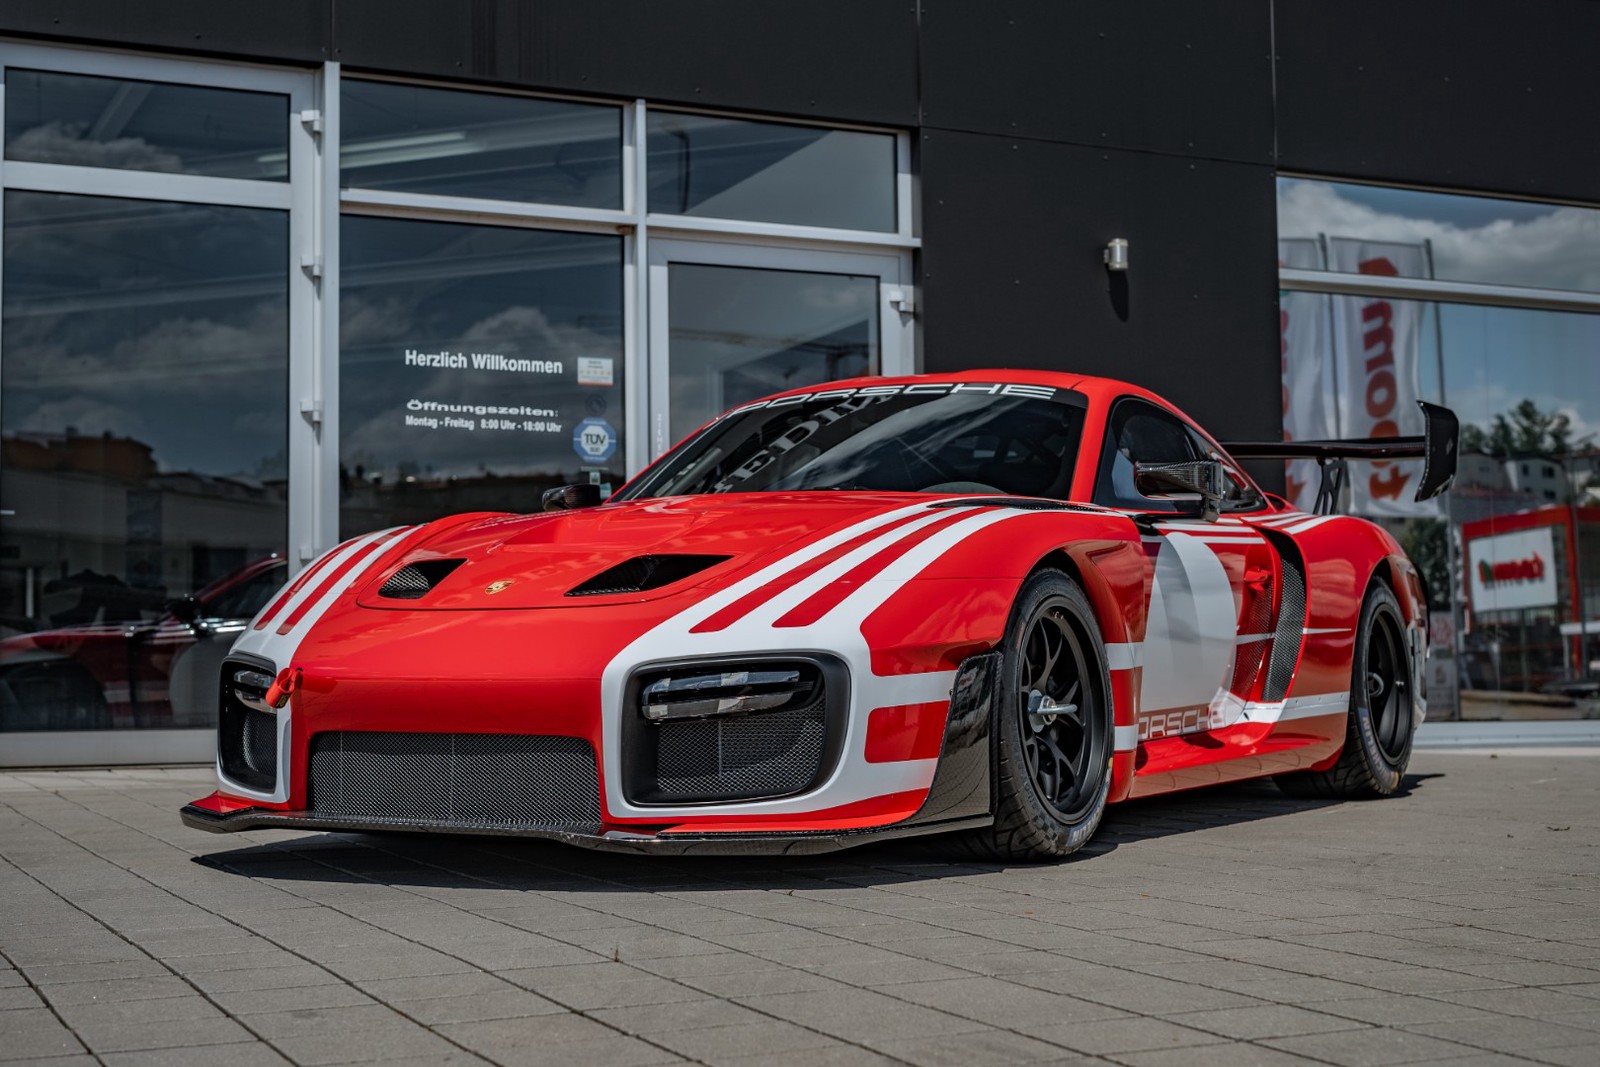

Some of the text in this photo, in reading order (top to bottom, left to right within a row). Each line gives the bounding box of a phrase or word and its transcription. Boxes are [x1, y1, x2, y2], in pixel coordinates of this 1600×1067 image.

[405, 349, 468, 369] Herzlich
[471, 353, 563, 374] Willkommen
[406, 399, 559, 417] Öffnungszeiten:
[726, 383, 1057, 419] PORSCHE
[405, 415, 438, 429] Montag
[444, 417, 475, 431] Freitag
[480, 418, 499, 430] 8:00
[500, 419, 516, 431] Uhr
[522, 420, 545, 432] 18:00
[546, 422, 562, 433] Uhr
[1138, 703, 1226, 740] ORSCHE
